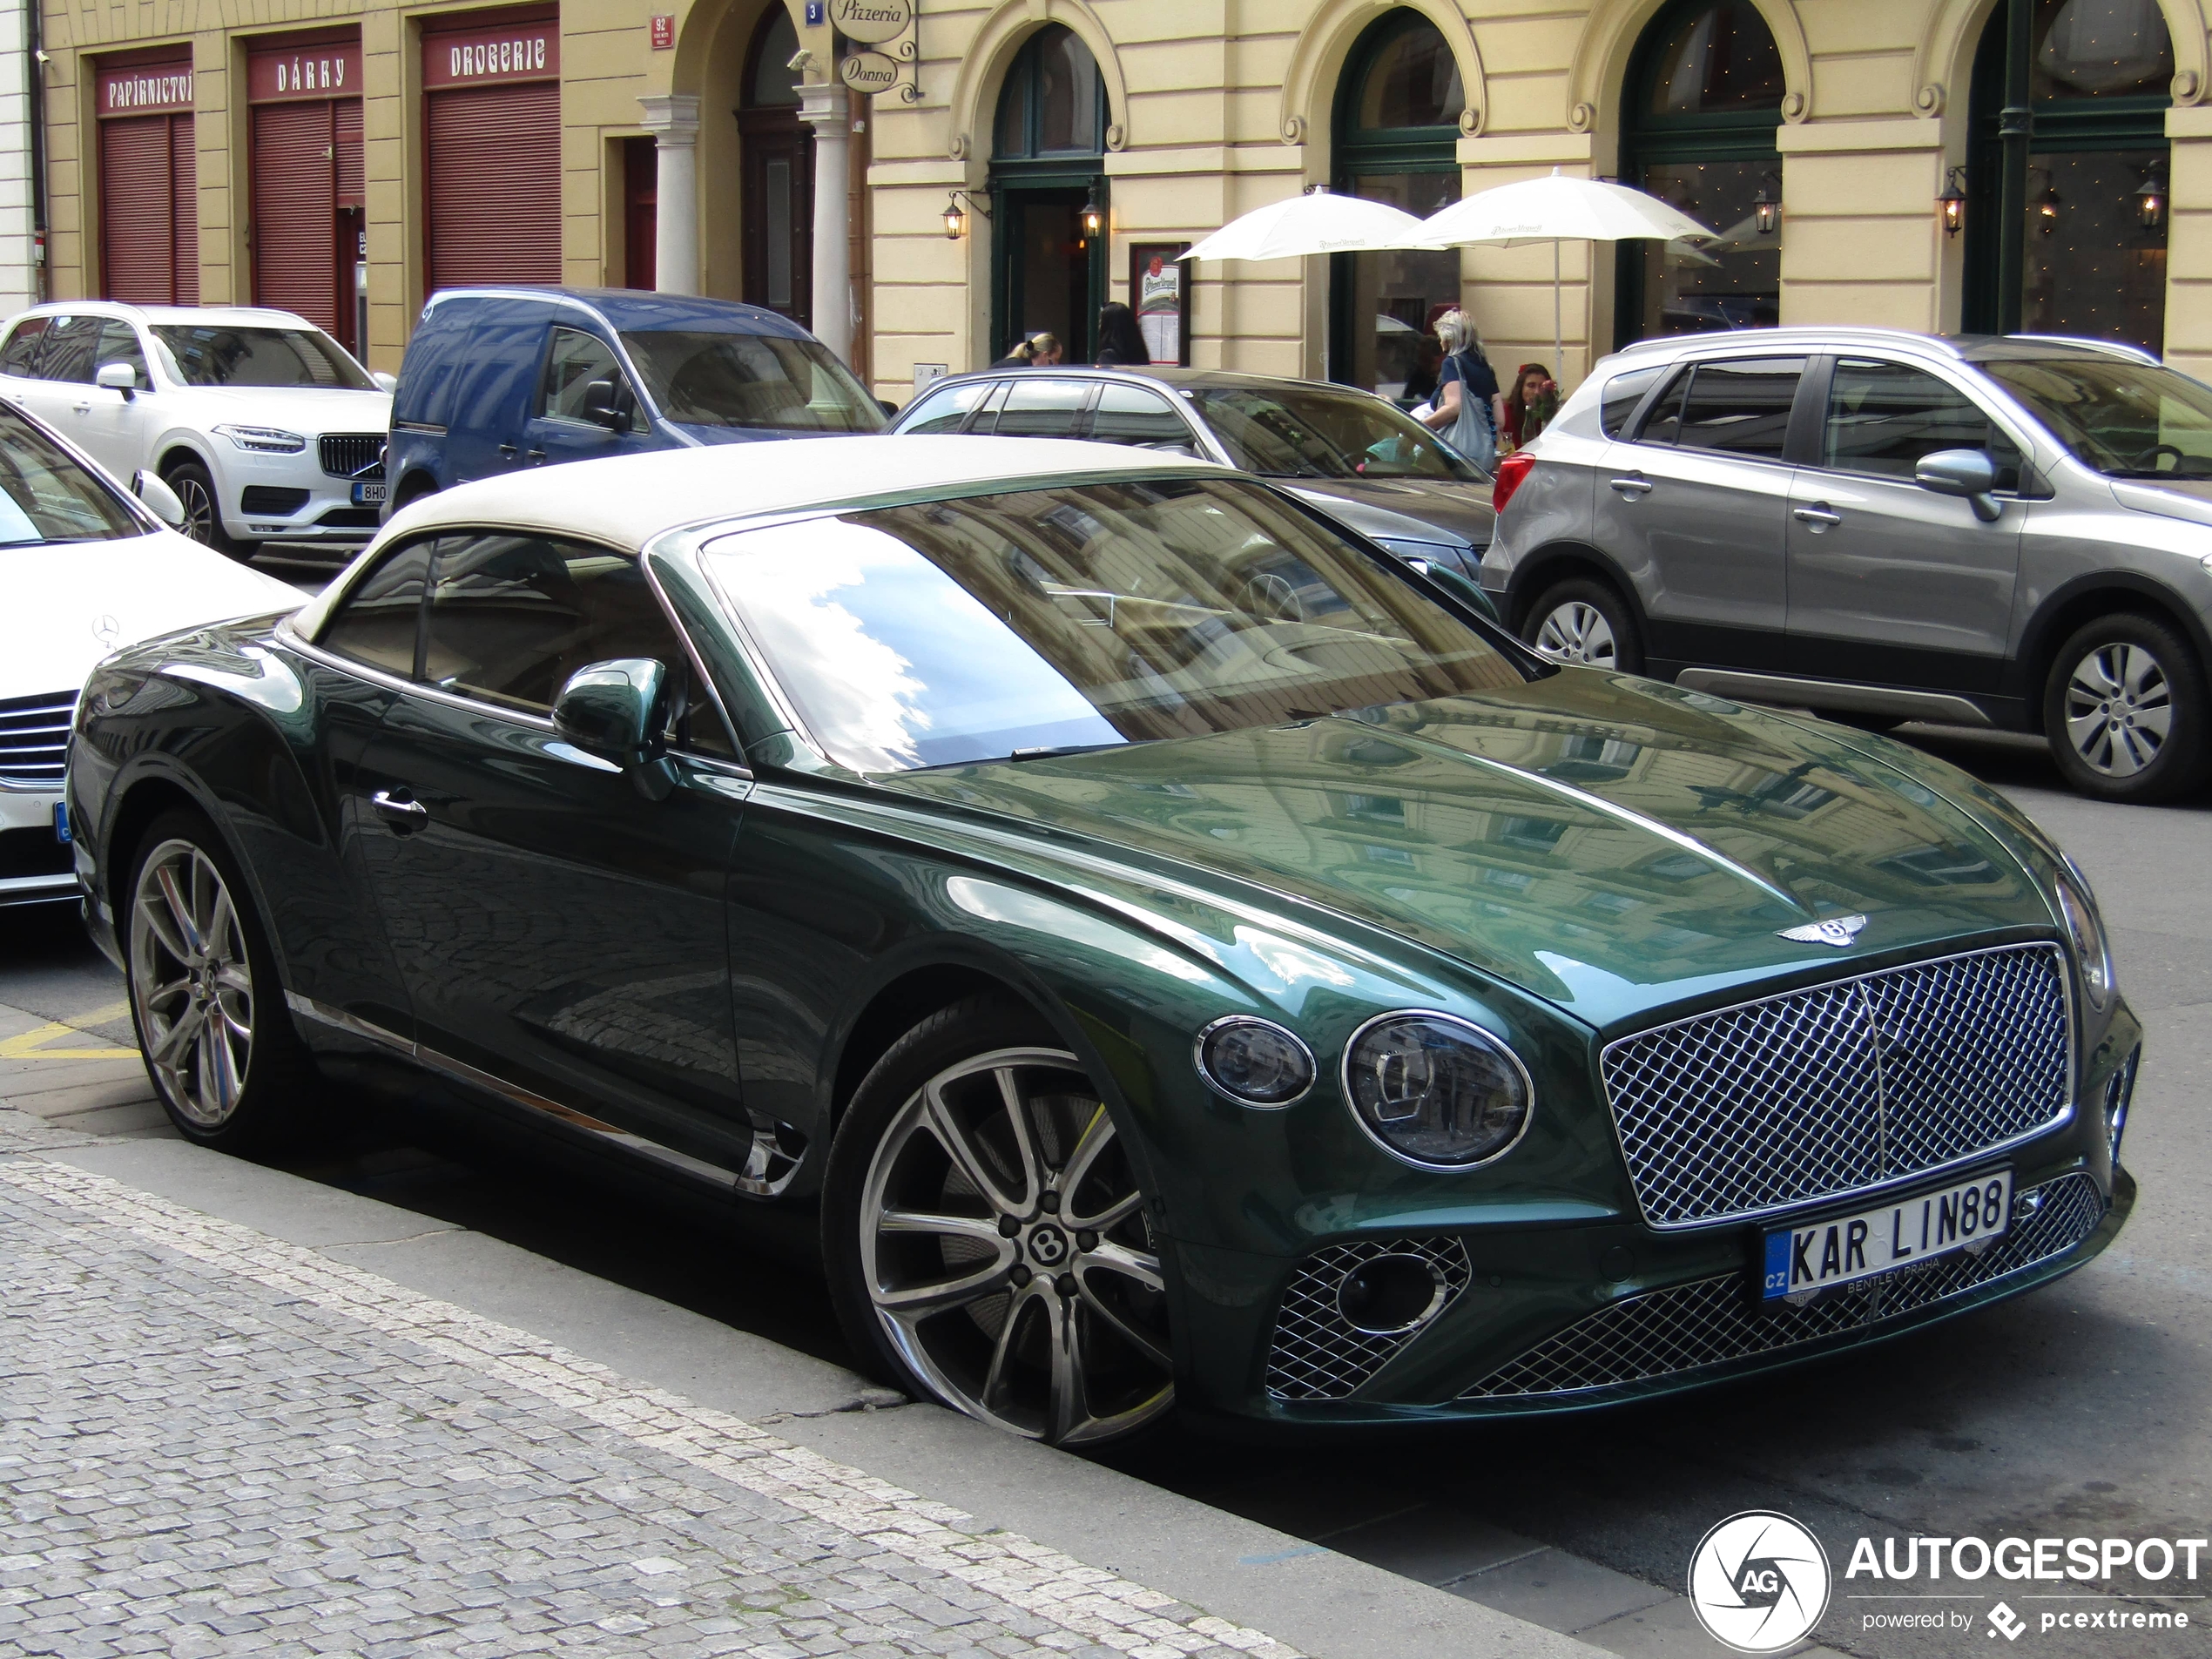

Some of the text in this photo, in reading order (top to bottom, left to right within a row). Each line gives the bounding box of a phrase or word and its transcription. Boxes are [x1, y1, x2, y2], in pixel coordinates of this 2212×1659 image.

[656, 18, 665, 31] 92
[810, 4, 816, 19] 3
[837, 0, 901, 22] Pizzeria
[451, 38, 545, 77] DROGERIE
[846, 57, 893, 82] Donna
[278, 57, 344, 91] DÁRKY
[109, 70, 192, 108] PAPÍRNICTVÍ
[1791, 1218, 1868, 1285] KAR
[1764, 1271, 1785, 1289] CZ
[1847, 1258, 1940, 1293] BENTLEY PRAHA
